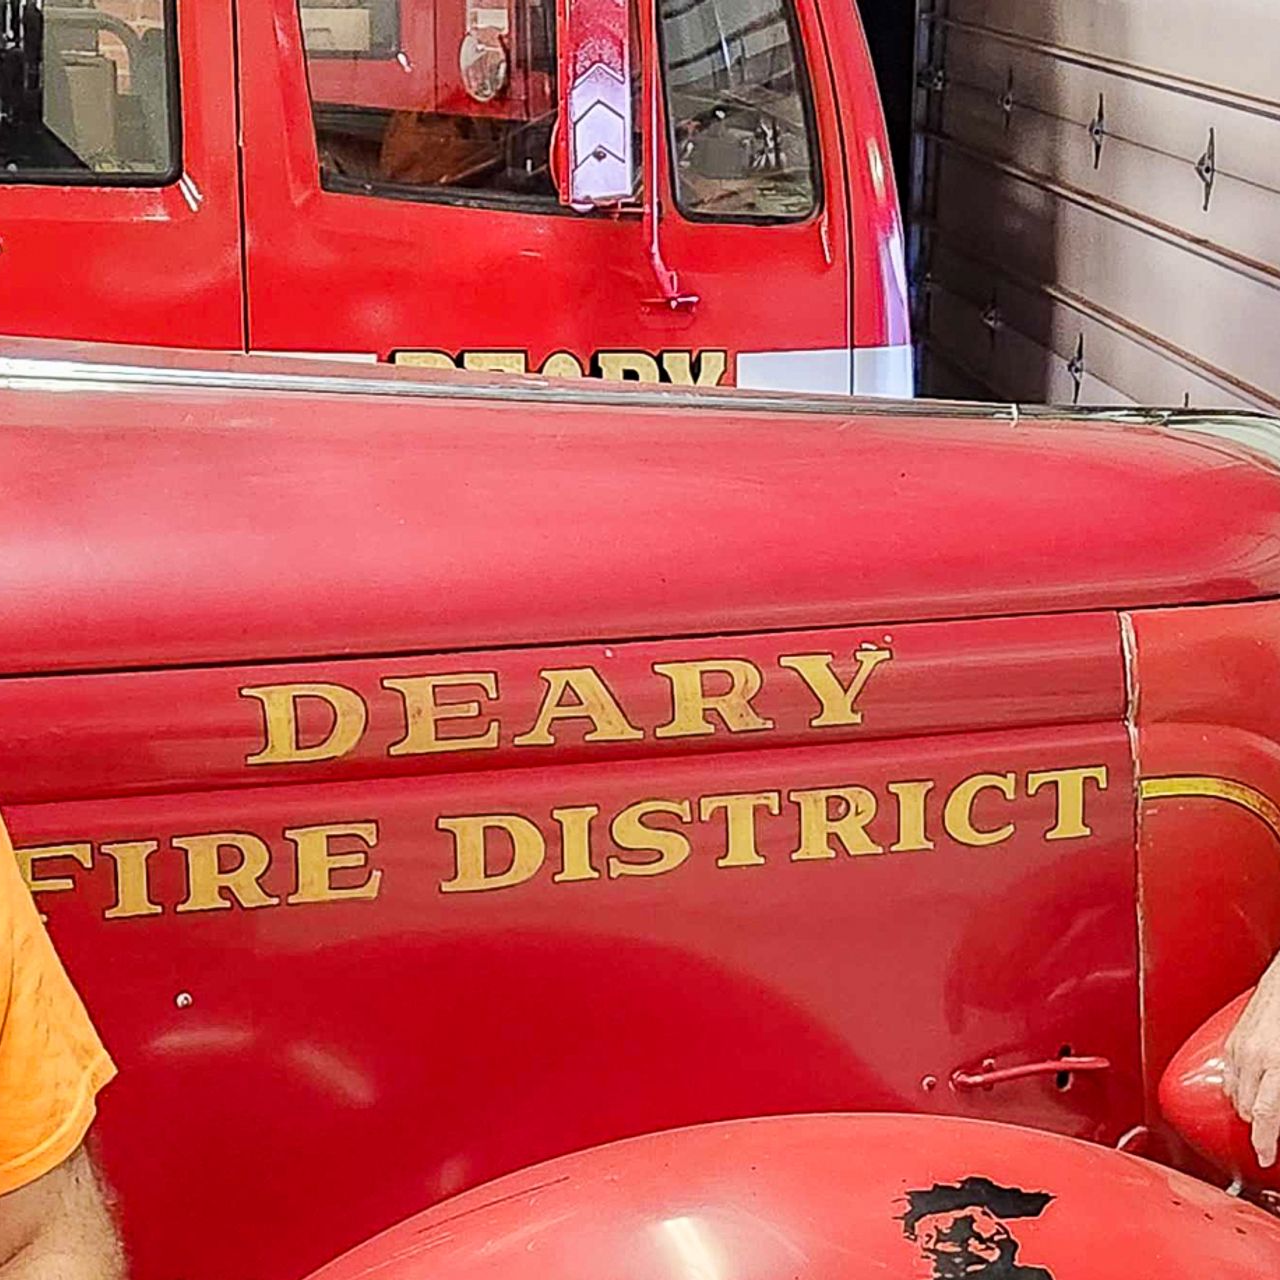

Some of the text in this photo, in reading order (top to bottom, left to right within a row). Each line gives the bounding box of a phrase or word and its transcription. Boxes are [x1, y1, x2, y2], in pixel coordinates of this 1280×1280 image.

[240, 649, 892, 766] DEARY
[14, 765, 1108, 922] FIRE DISTRICT
